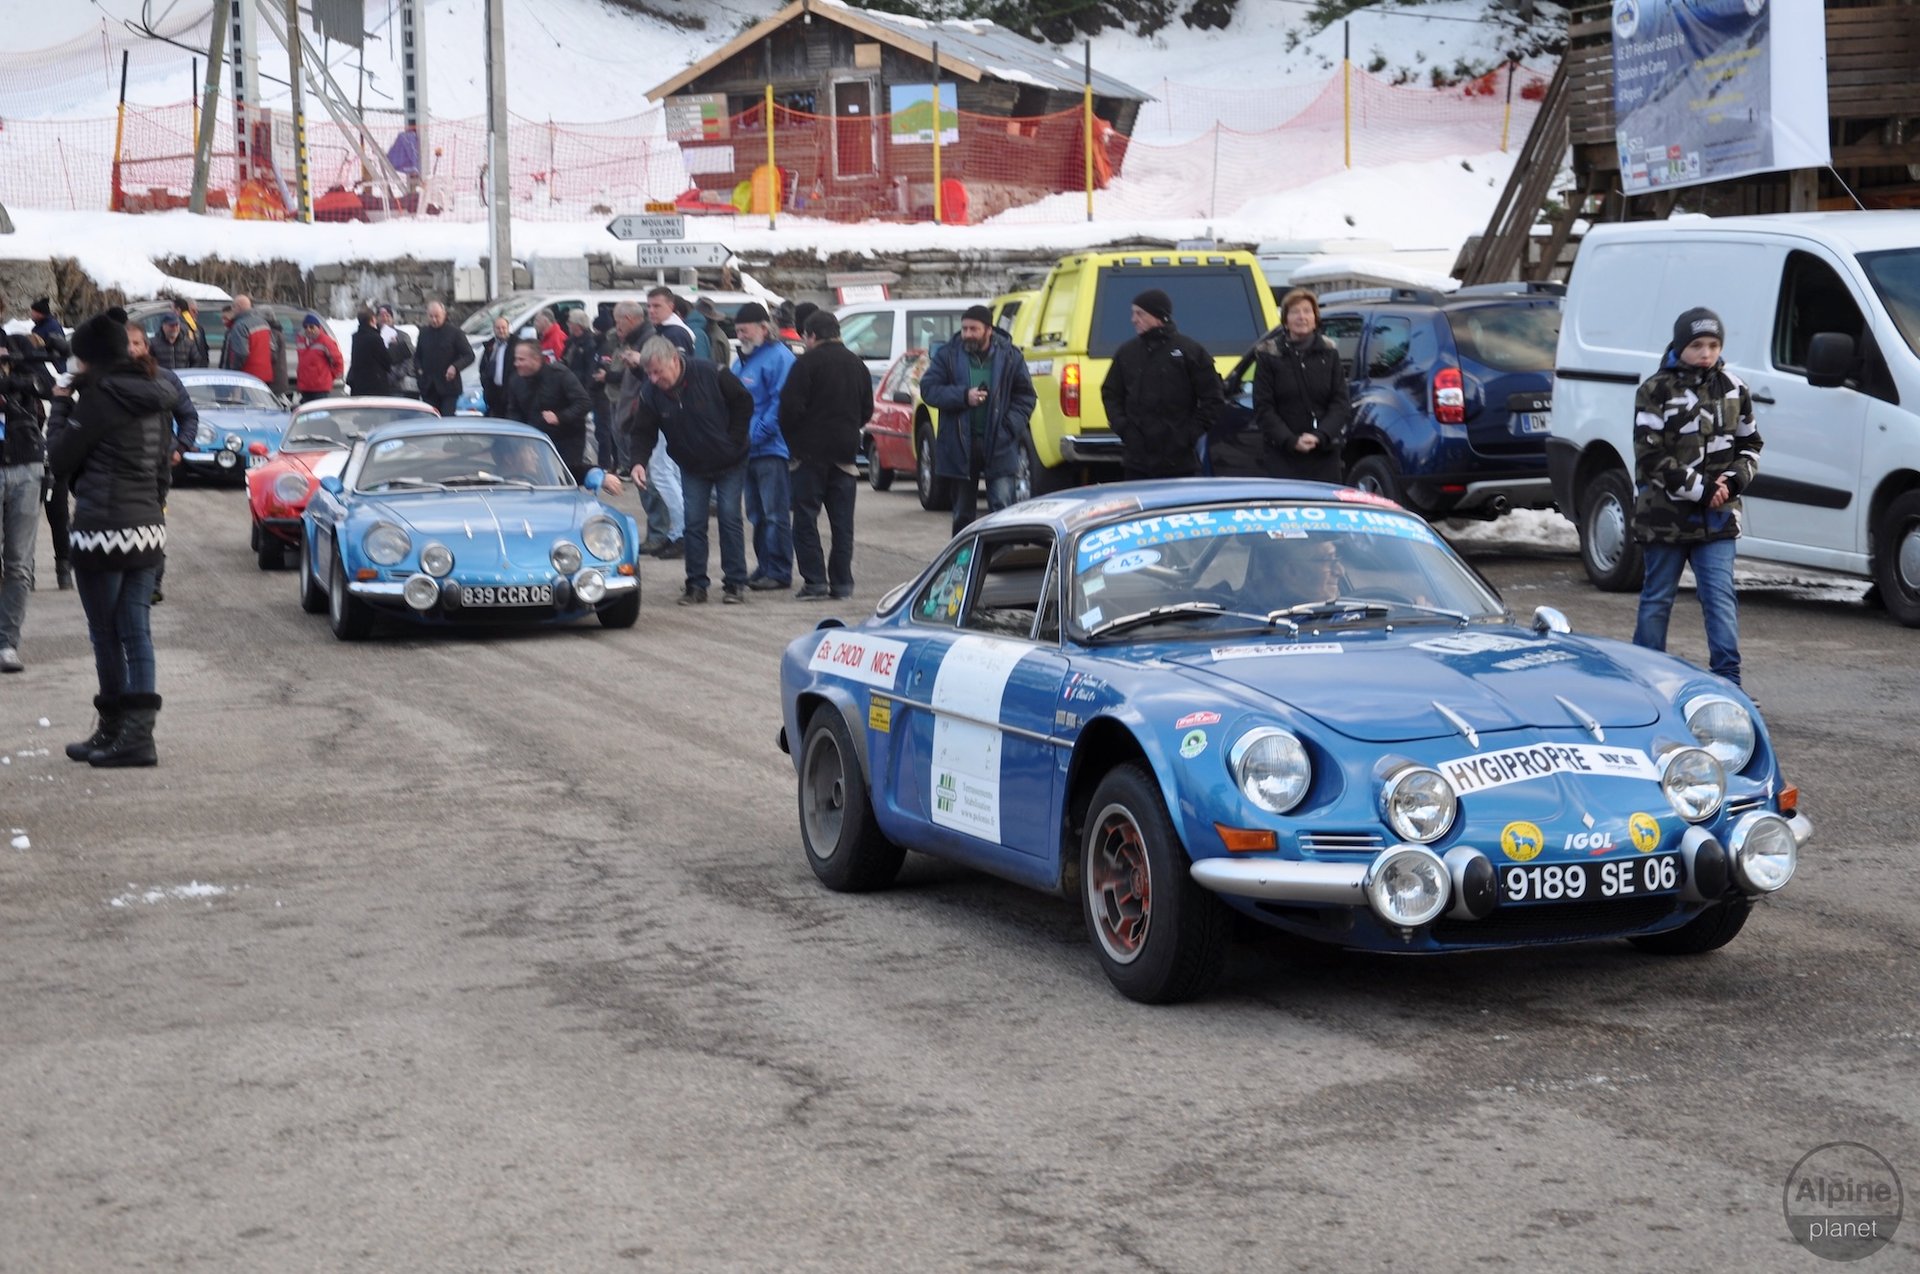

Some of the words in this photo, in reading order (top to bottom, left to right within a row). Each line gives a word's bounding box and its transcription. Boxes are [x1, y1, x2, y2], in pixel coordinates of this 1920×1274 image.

[1633, 40, 1655, 56] Février
[1656, 34, 1672, 51] 2016
[1617, 66, 1638, 81] Station
[1640, 62, 1648, 76] de
[1648, 60, 1667, 75] Camp
[623, 219, 632, 227] 12
[641, 218, 680, 227] MOULINET
[649, 228, 680, 237] SOSPEL
[641, 246, 669, 254] PEIRA
[674, 245, 698, 254] CAVA
[641, 256, 664, 265] NICE
[708, 256, 719, 264] 47
[1079, 511, 1217, 553] CENTRE
[1232, 508, 1326, 522] AUTO
[1164, 532, 1184, 541] 93
[1243, 523, 1264, 532] 22
[1120, 555, 1143, 567] 43
[464, 586, 495, 604] 839
[497, 586, 528, 604] CCR
[531, 585, 552, 603] 06
[833, 643, 865, 668] CHIODI
[871, 651, 895, 676] NICE
[1448, 746, 1592, 791] HYGIPROPRE
[1564, 832, 1613, 850] IGOL
[1507, 865, 1586, 901] 9189
[1601, 861, 1634, 896] SE
[1644, 856, 1676, 891] 06
